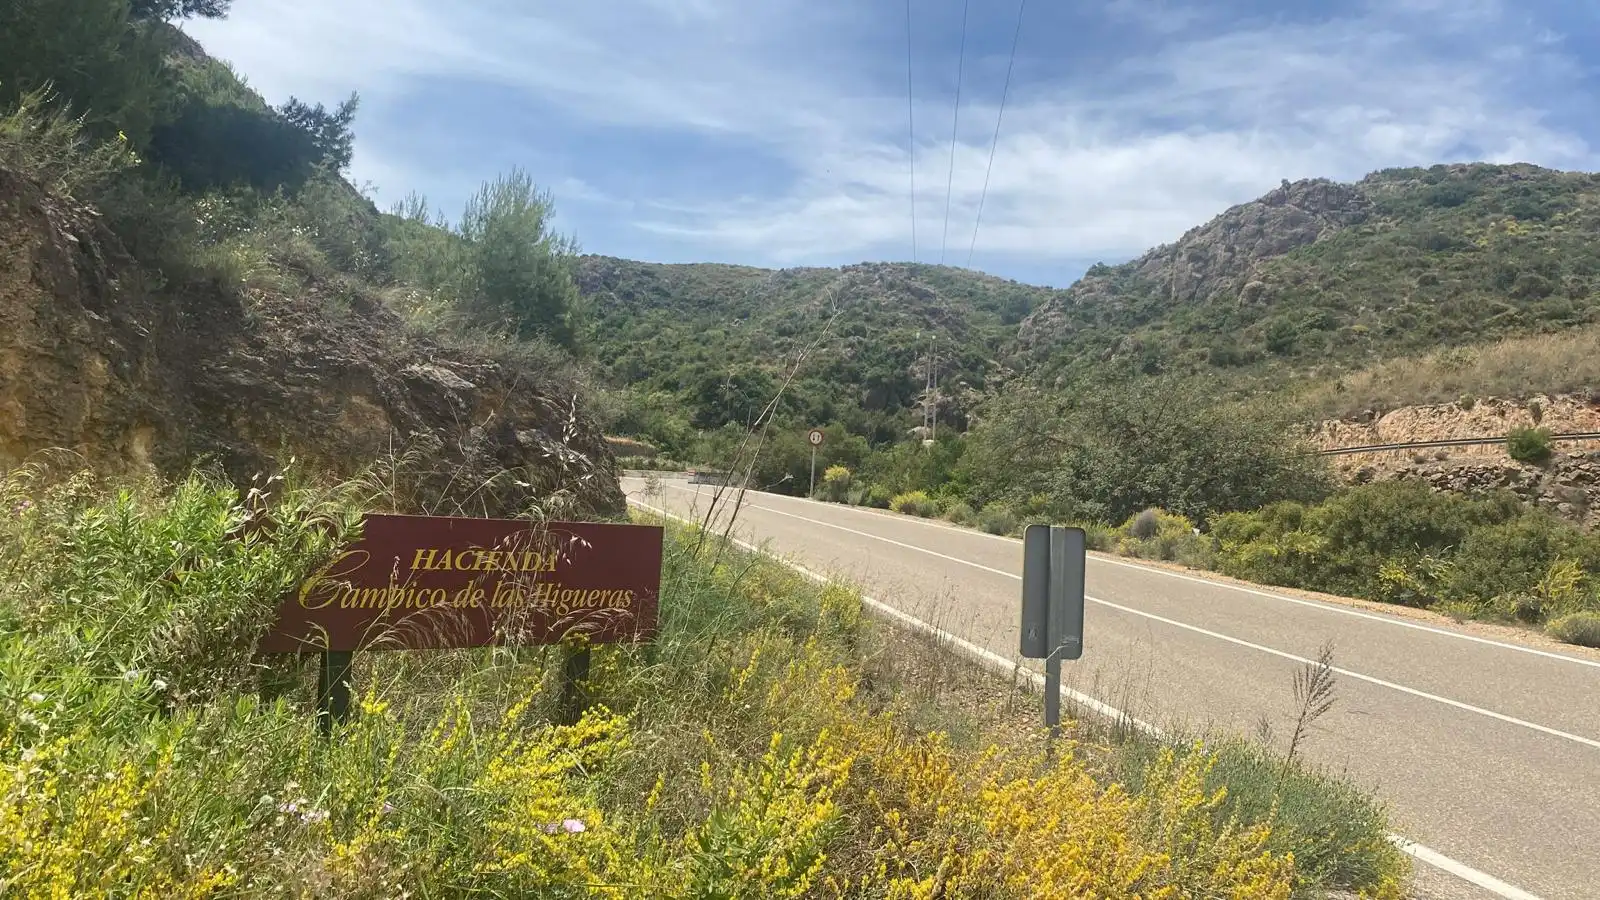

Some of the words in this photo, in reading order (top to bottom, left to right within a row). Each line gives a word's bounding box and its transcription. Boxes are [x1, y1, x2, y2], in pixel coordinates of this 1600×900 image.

[298, 549, 447, 617] Campico
[453, 580, 485, 609] de
[490, 580, 526, 609] las
[534, 582, 634, 616] Higueras
[410, 549, 557, 572] HACIENDA
